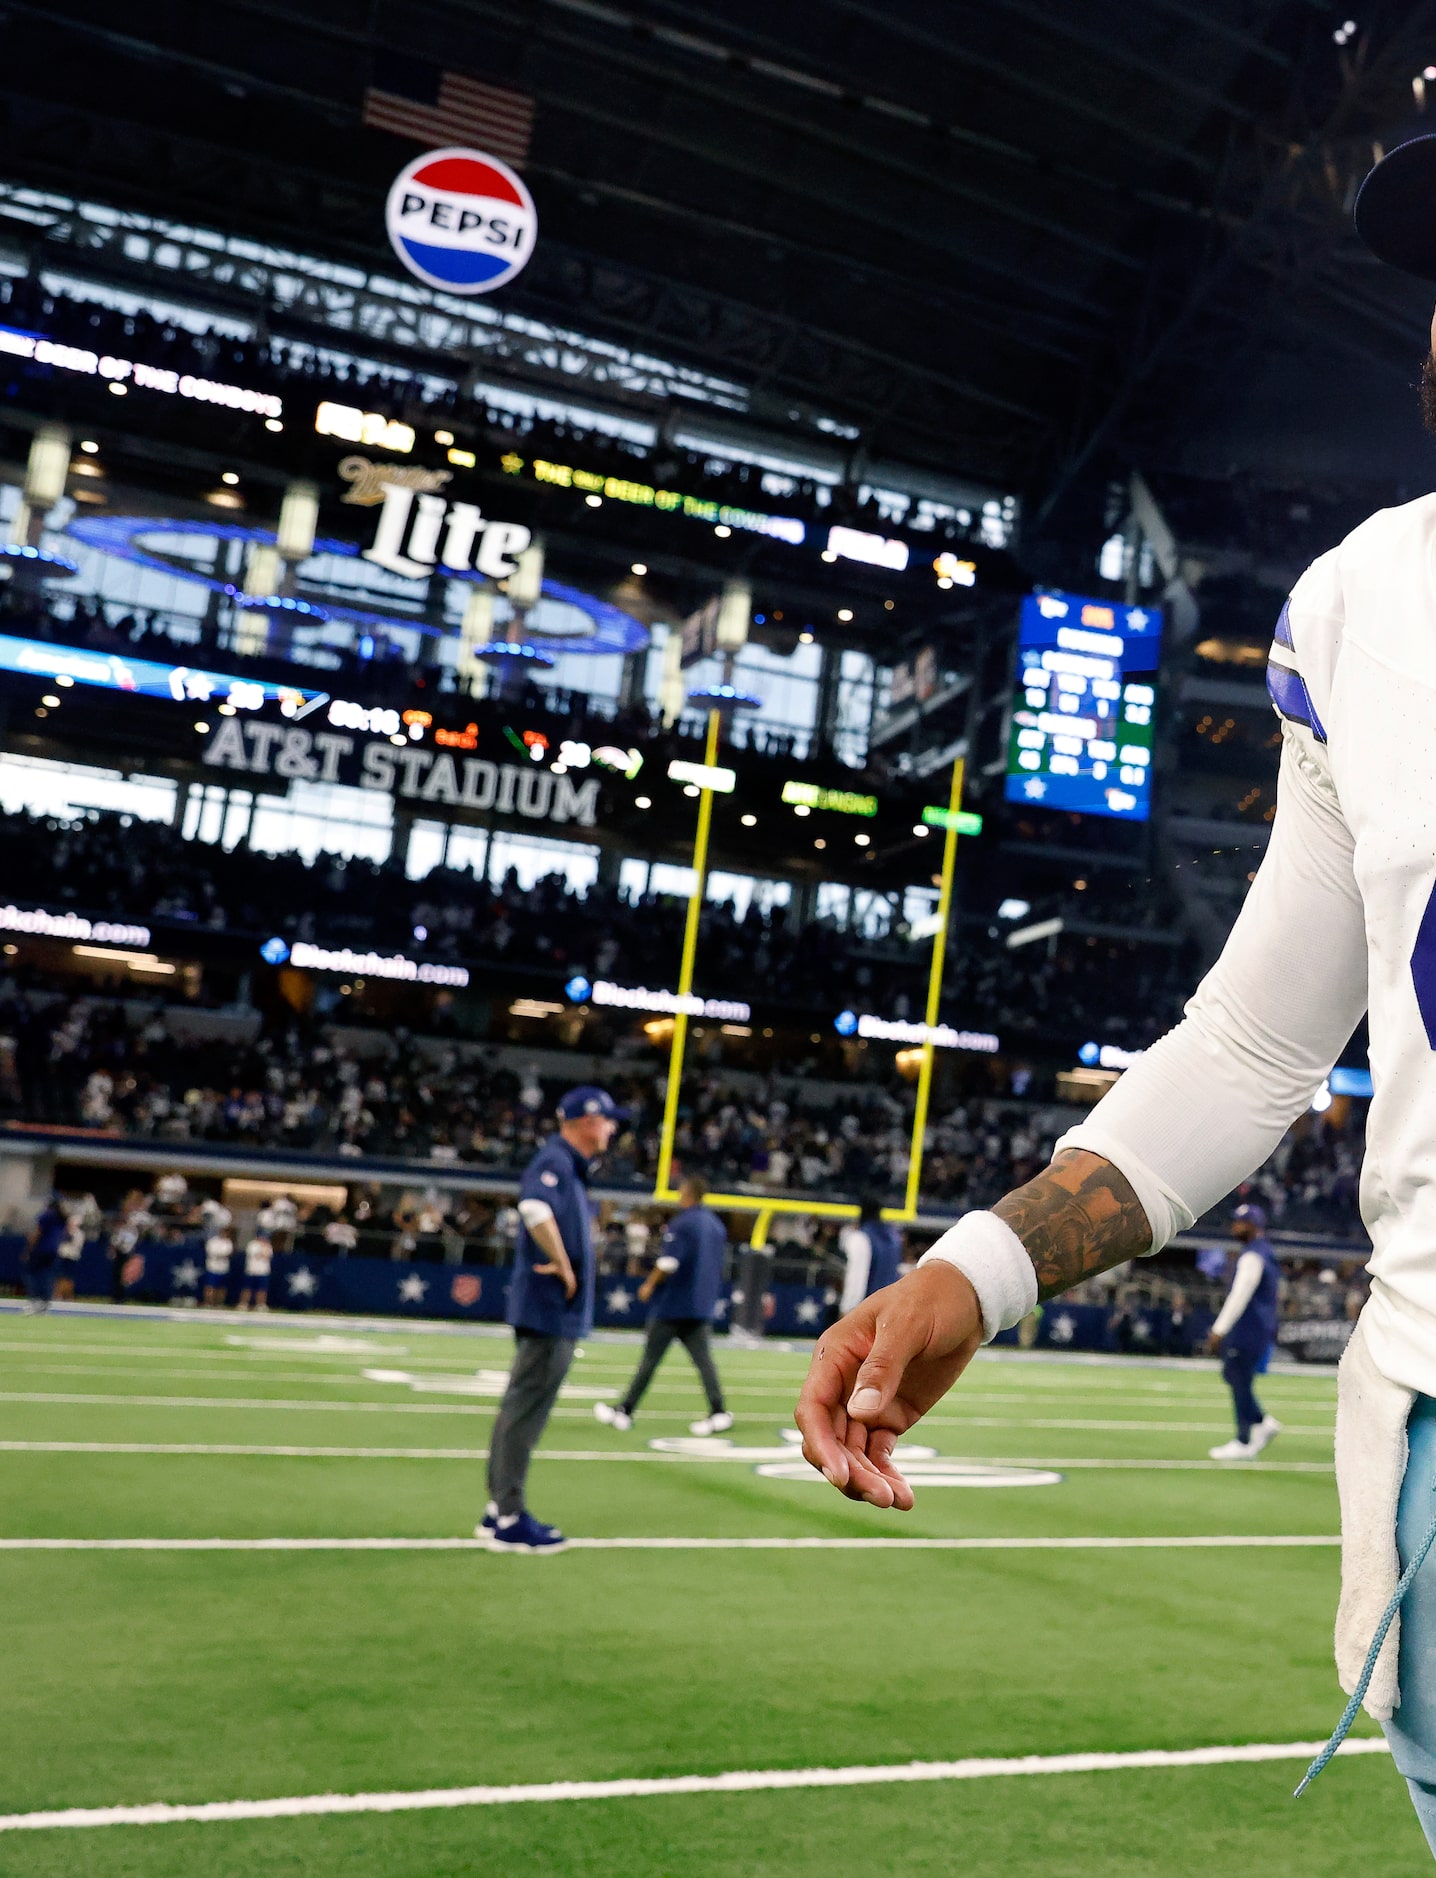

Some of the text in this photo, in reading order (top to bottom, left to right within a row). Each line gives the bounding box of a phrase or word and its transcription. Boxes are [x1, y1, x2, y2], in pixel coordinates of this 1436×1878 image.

[401, 193, 524, 249] PEPSI
[362, 483, 532, 580] Lite
[202, 716, 354, 783] AT&T
[359, 740, 601, 827] STADIUM
[290, 942, 469, 987] Blockchain.com
[592, 980, 750, 1022] Blockchain.com
[858, 1014, 999, 1053] Blockchain.com
